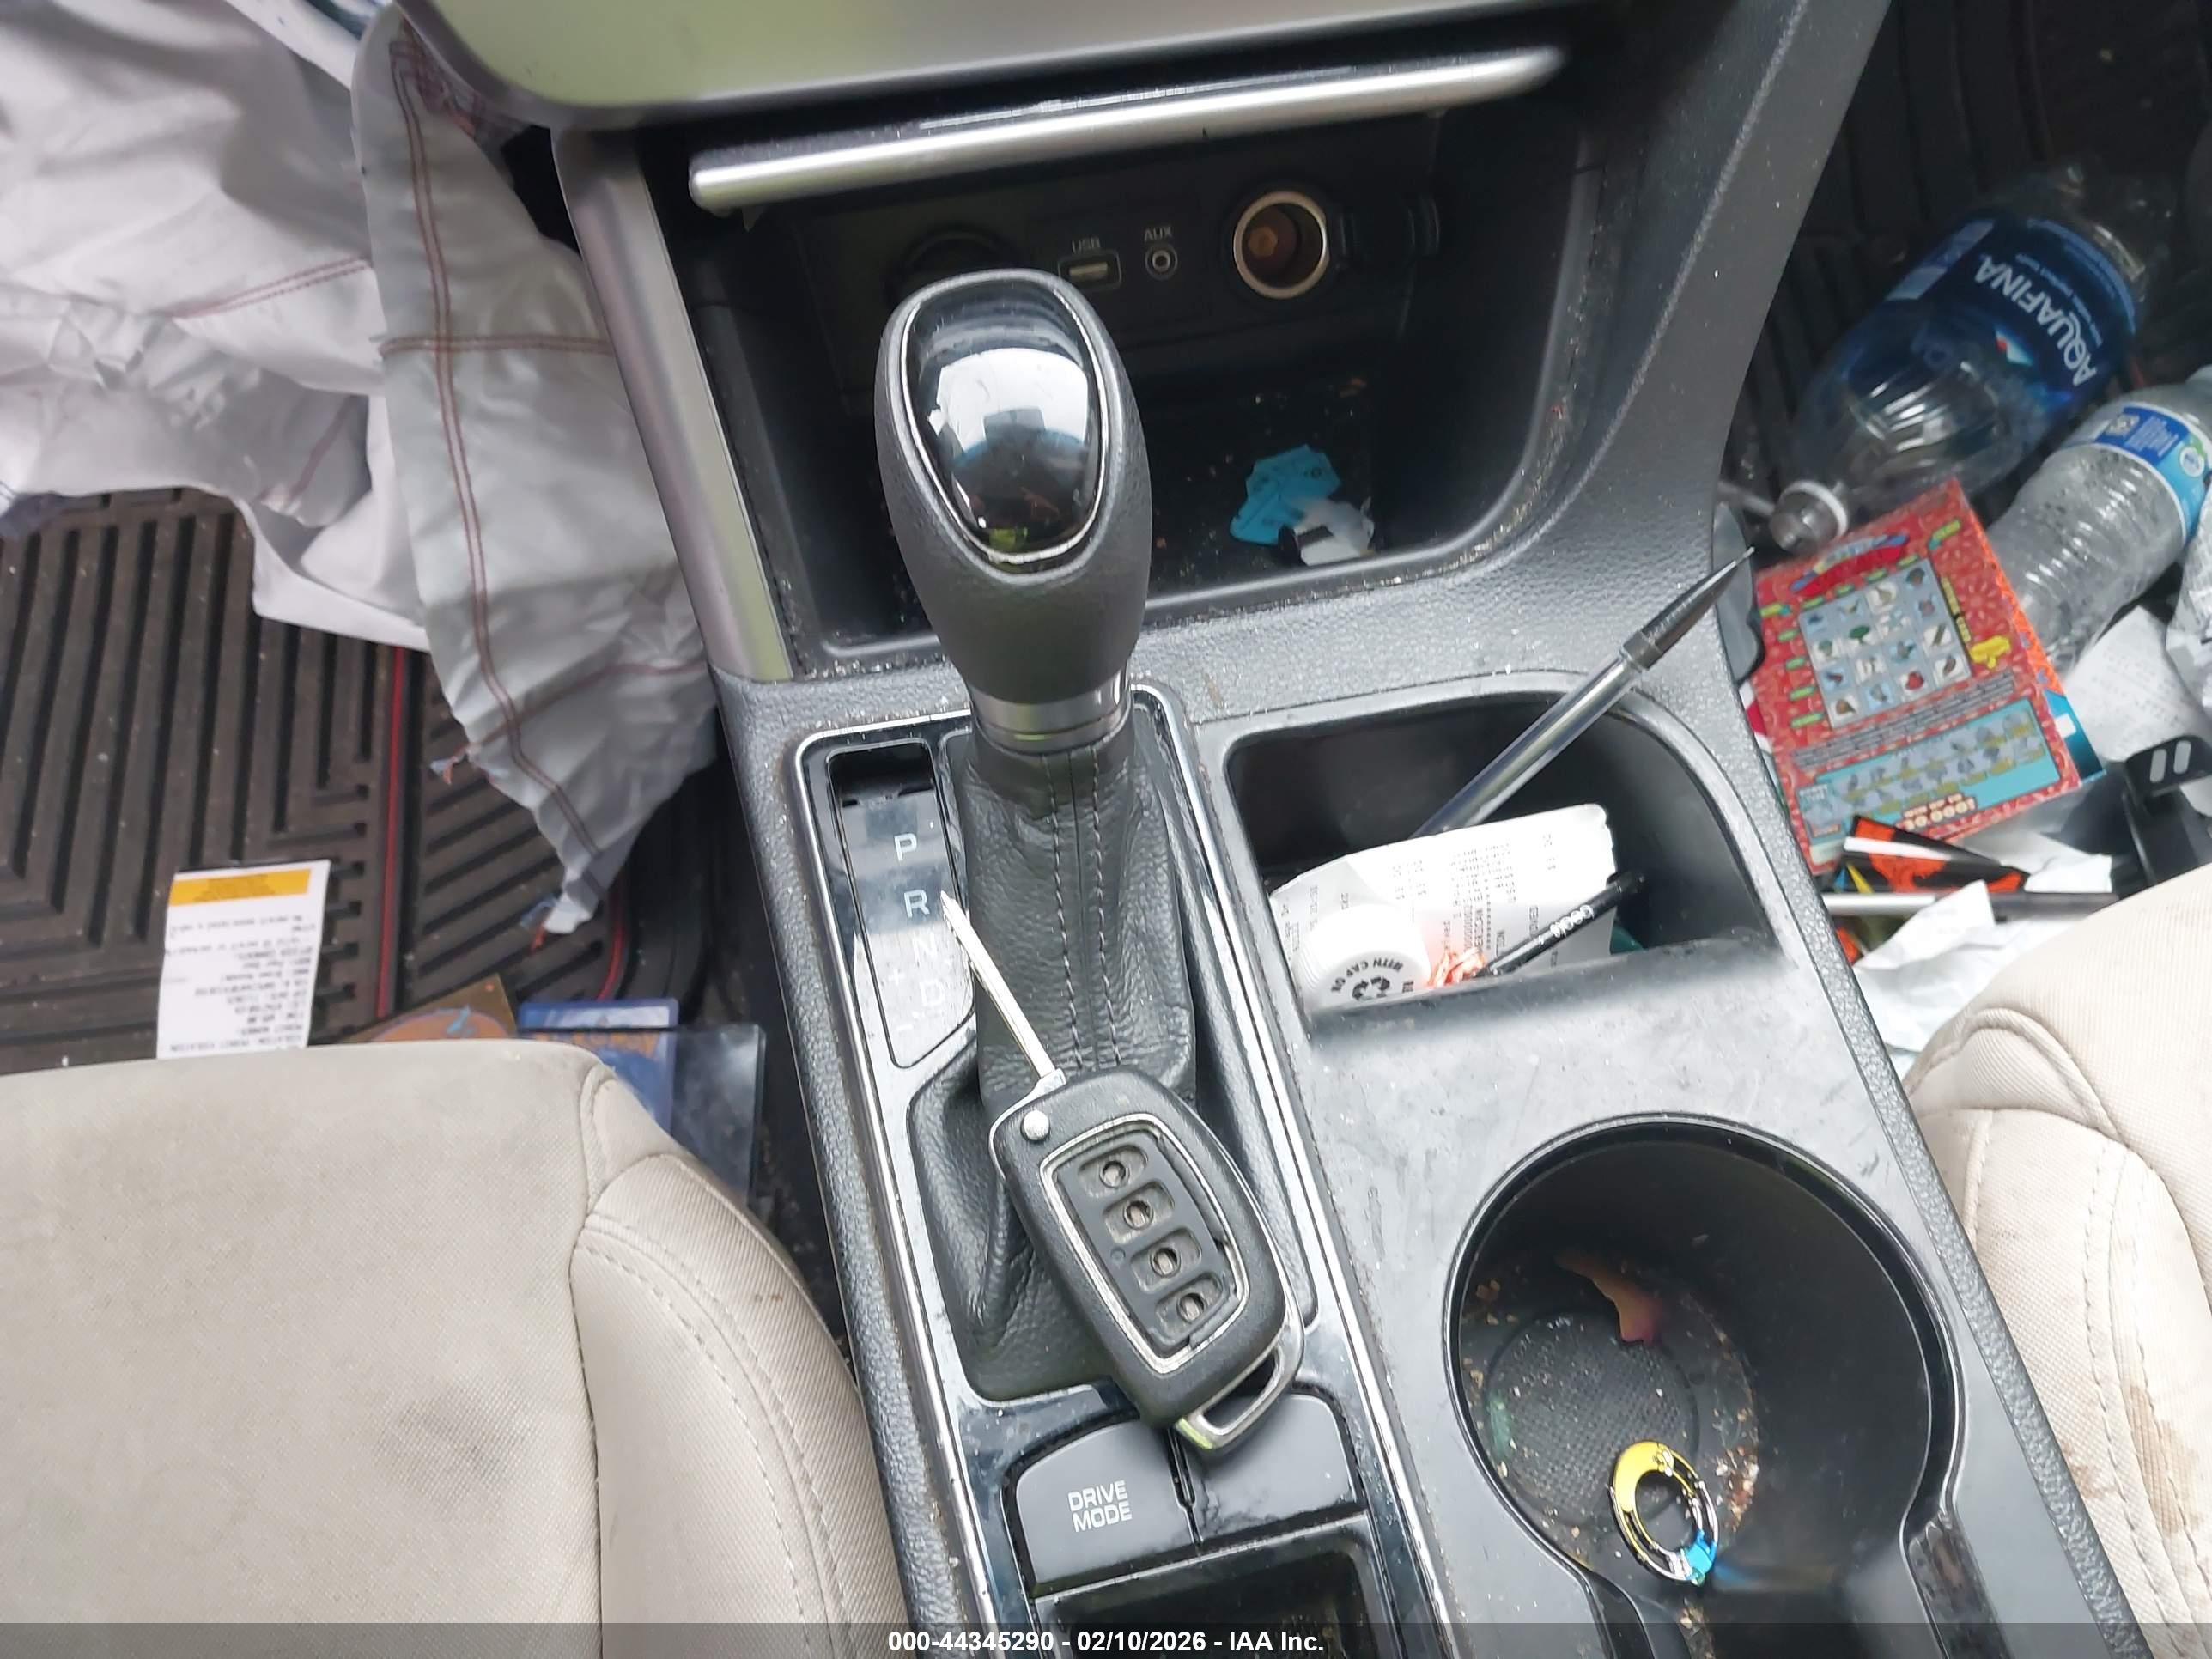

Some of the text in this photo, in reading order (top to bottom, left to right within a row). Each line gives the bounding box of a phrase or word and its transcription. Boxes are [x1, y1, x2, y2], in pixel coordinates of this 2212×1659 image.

[1071, 236, 1101, 255] USB
[1144, 226, 1172, 243] AUX
[1975, 255, 2097, 387] AQUAFINA
[894, 833, 917, 861] P
[904, 889, 930, 918] R
[913, 928, 938, 961] N
[920, 981, 943, 1007] D
[1067, 1480, 1128, 1512] DRIVE
[1072, 1501, 1133, 1533] MODE
